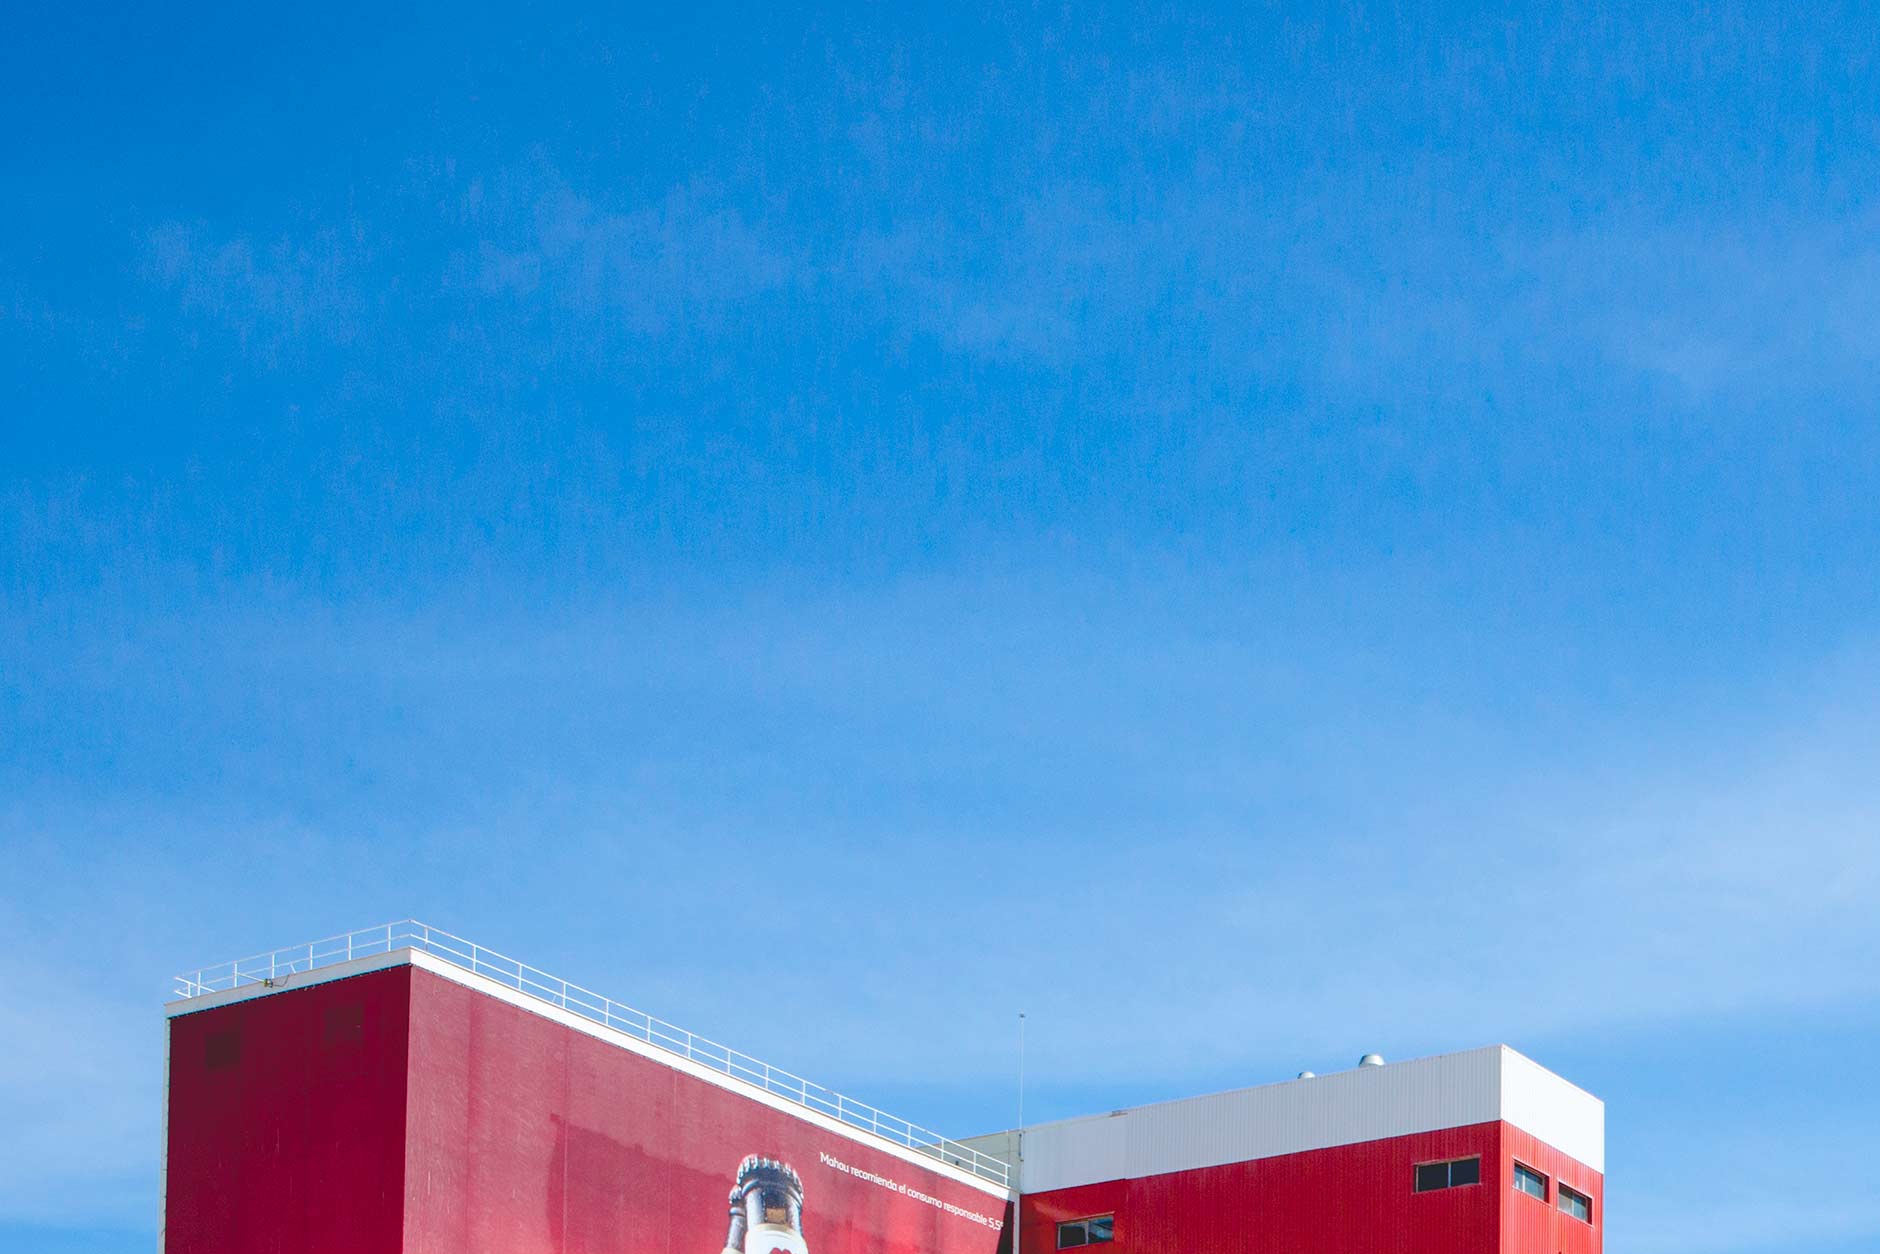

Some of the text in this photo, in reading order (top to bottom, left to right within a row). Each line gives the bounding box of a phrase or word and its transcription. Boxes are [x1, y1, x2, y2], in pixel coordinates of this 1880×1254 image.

[820, 1151, 849, 1173] Mahou
[850, 1166, 898, 1192] recomienda
[898, 1183, 908, 1195] el
[907, 1188, 943, 1209] consumo
[943, 1201, 988, 1226] responsable
